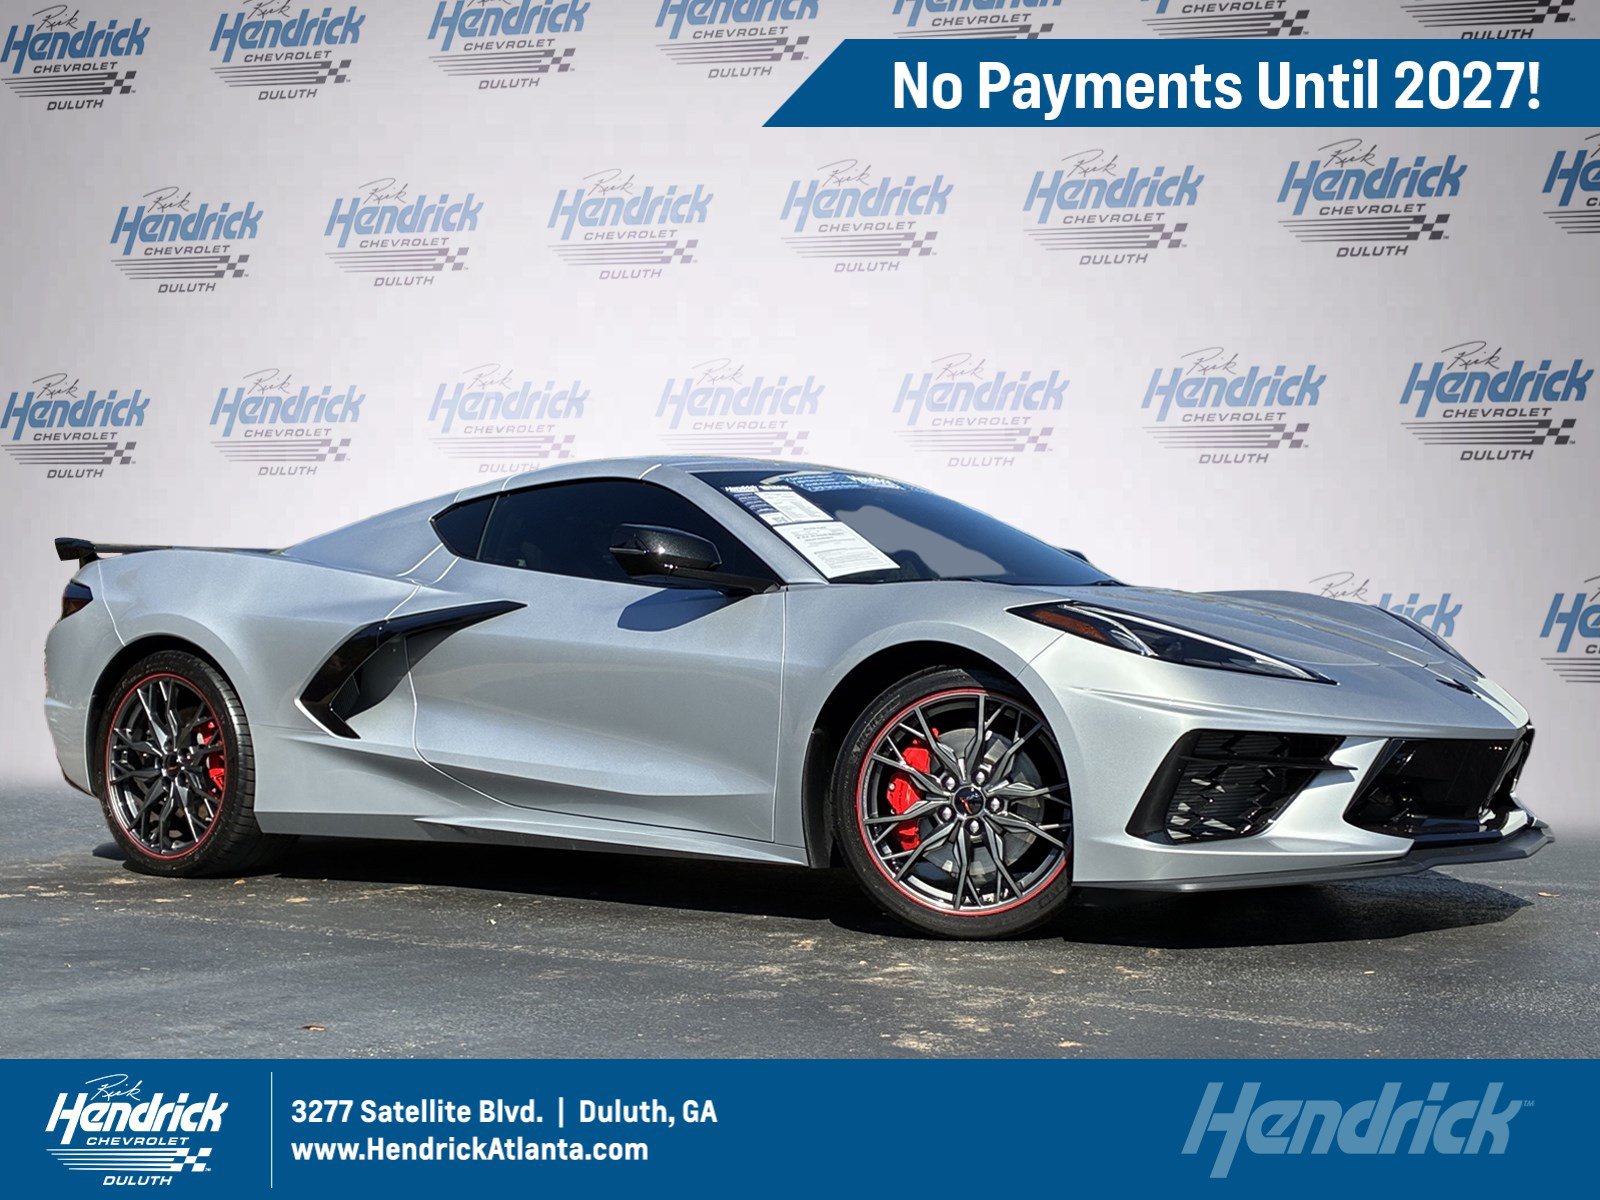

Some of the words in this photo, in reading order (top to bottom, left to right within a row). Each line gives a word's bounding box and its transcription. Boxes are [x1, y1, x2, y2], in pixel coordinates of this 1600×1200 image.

[1182, 0, 1287, 13] CHEVROLET
[931, 13, 1032, 26] CHEVROLET
[428, 0, 590, 51] Hendrick
[210, 6, 366, 63] Hendrick
[691, 26, 788, 39] CHEVROLET
[0, 18, 149, 74] Hendrick
[464, 39, 555, 51] CHEVROLET
[244, 50, 332, 62] CHEVROLET
[33, 62, 118, 73] CHEVROLET
[708, 66, 772, 78] DULUTH
[479, 78, 540, 89] DULUTH
[258, 89, 317, 100] DULUTH
[47, 99, 104, 110] DULUTH
[1278, 154, 1467, 215] Hendrick
[1024, 165, 1204, 224] Hendrick
[781, 175, 953, 233] Hendrick
[1319, 203, 1427, 215] CHEVROLET
[548, 184, 712, 240] Hendrick
[325, 193, 484, 248] Hendrick
[1063, 213, 1165, 224] CHEVROLET
[111, 202, 263, 256] Hendrick
[818, 221, 916, 232] CHEVROLET
[584, 229, 678, 240] CHEVROLET
[360, 237, 449, 248] CHEVROLET
[144, 245, 230, 256] CHEVROLET
[1337, 245, 1408, 257] DULUTH
[1080, 253, 1148, 265] DULUTH
[834, 261, 900, 272] DULUTH
[599, 269, 662, 279] DULUTH
[374, 276, 434, 286] DULUTH
[158, 283, 216, 293] DULUTH
[1142, 364, 1327, 420] Hendrick
[1400, 359, 1594, 417] Hendrick
[656, 374, 824, 428] Hendrick
[893, 370, 1071, 426] Hendrick
[210, 385, 365, 438] Hendrick
[427, 379, 589, 433] Hendrick
[0, 389, 149, 440] Hendrick
[1183, 412, 1286, 422] CHEVROLET
[1443, 408, 1552, 418] CHEVROLET
[692, 421, 788, 430] CHEVROLET
[932, 416, 1032, 426] CHEVROLET
[244, 428, 332, 438] CHEVROLET
[464, 425, 555, 434] CHEVROLET
[33, 432, 117, 441] CHEVROLET
[1199, 453, 1269, 463] DULUTH
[1460, 450, 1534, 460] DULUTH
[948, 456, 1015, 467] DULUTH
[47, 469, 103, 478] DULUTH
[258, 466, 317, 475] DULUTH
